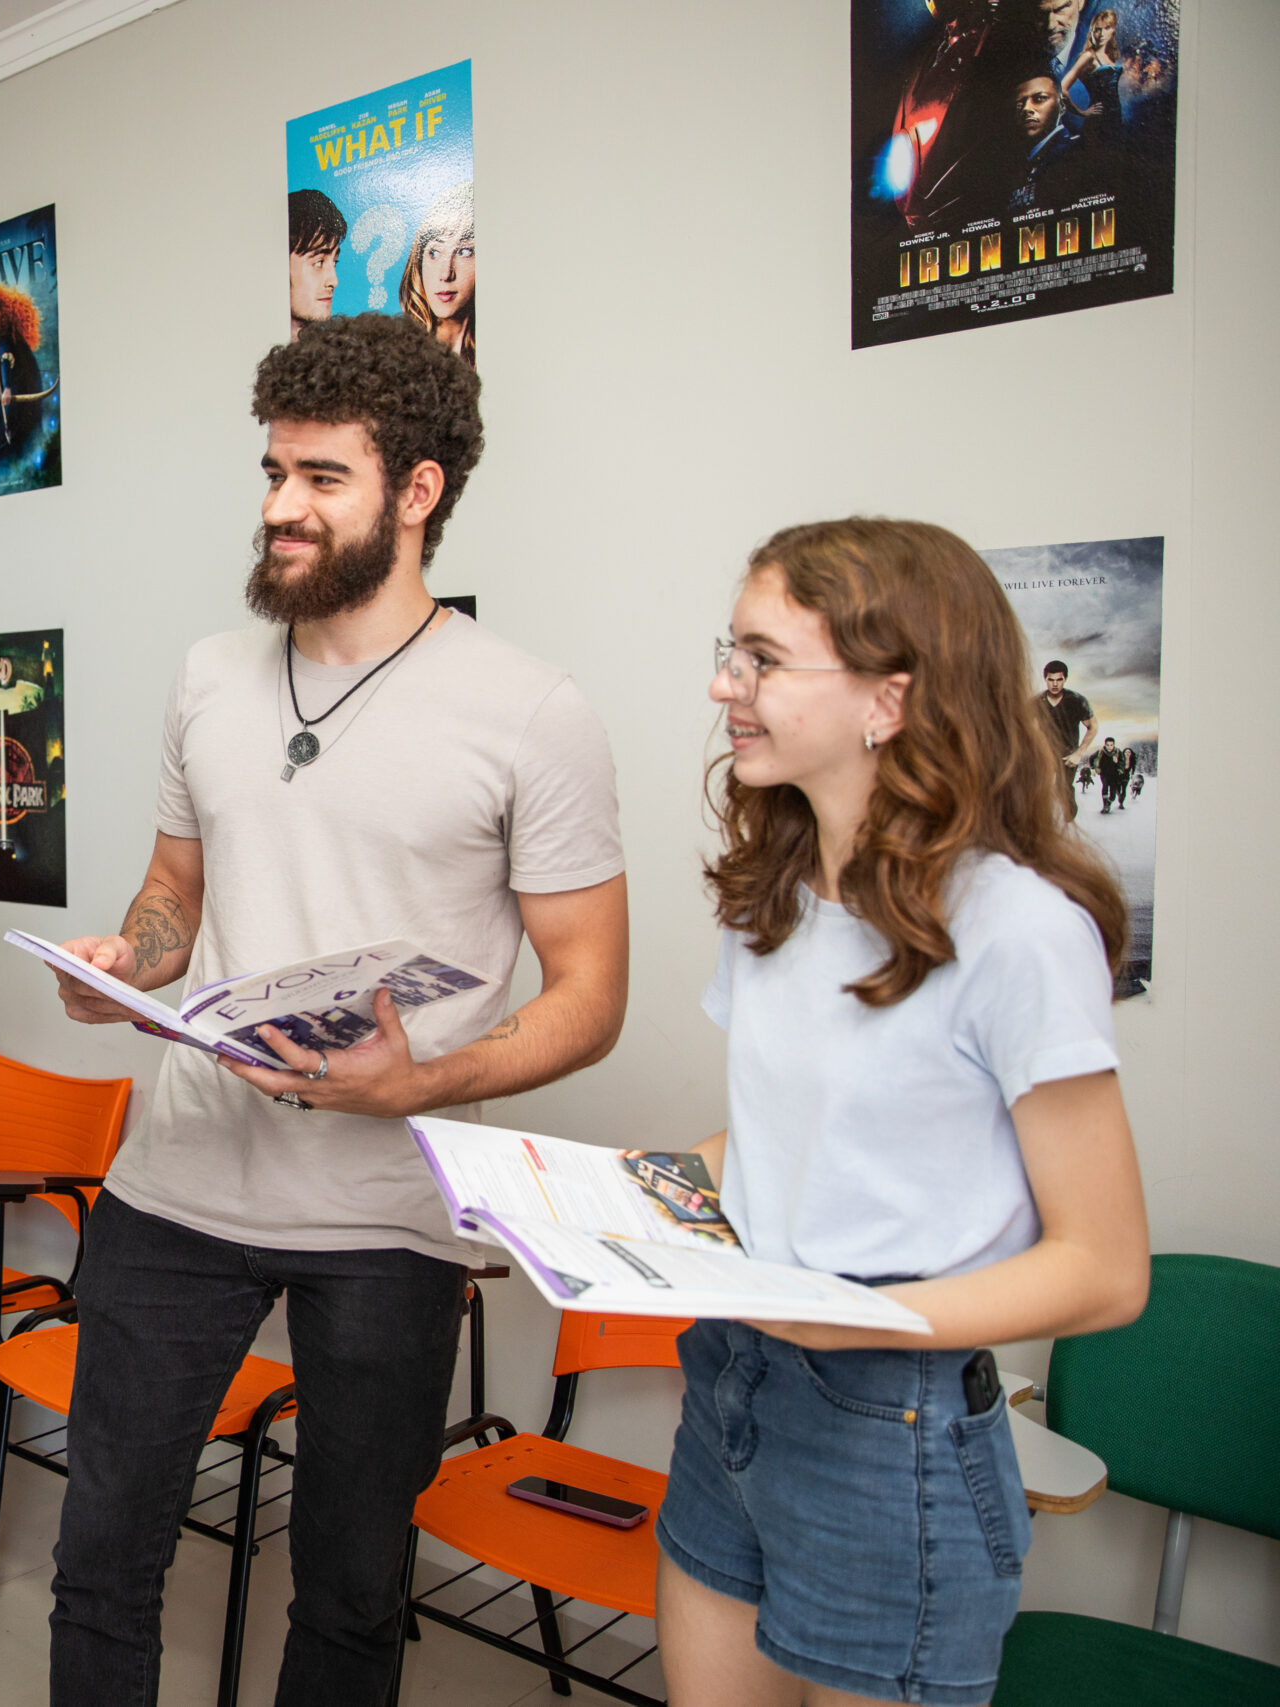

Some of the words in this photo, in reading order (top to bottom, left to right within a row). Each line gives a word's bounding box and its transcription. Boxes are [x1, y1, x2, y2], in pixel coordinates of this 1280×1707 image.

[388, 105, 408, 118] PARK
[351, 115, 377, 129] KAZAN
[315, 117, 407, 171] WHAT
[415, 105, 443, 141] IF
[1071, 195, 1116, 210] PALTROW
[1012, 209, 1055, 223] BRIDGES
[962, 221, 1001, 234] HOWARD
[899, 235, 935, 248] DOWNEY
[900, 232, 1002, 288] IRON
[1019, 207, 1116, 265] MAN
[1004, 581, 1029, 591] WILL
[1032, 580, 1055, 589] LIVE
[13, 783, 45, 808] PARK
[216, 950, 398, 1021] EVOLVE
